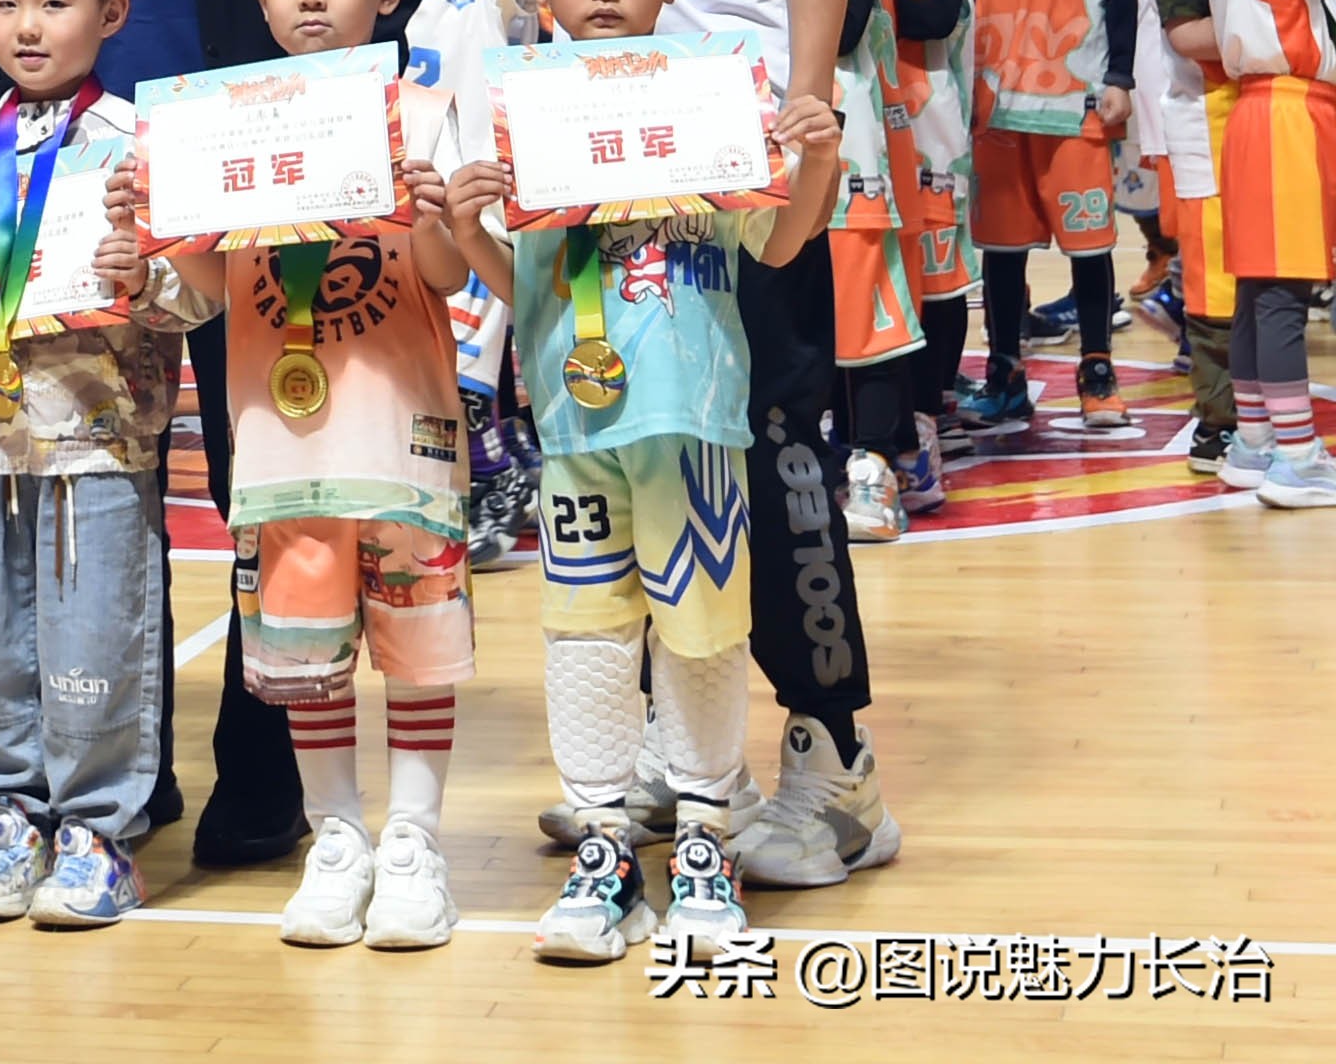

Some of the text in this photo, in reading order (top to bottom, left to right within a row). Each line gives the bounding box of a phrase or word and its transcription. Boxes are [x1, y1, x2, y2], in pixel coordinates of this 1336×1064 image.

[588, 125, 677, 165] 冠军
[221, 151, 305, 194] 冠军
[1059, 188, 1111, 233] 29
[665, 240, 732, 296] MAN
[918, 226, 958, 275] 17
[253, 275, 400, 345] BASETBALL
[552, 494, 612, 543] 23
